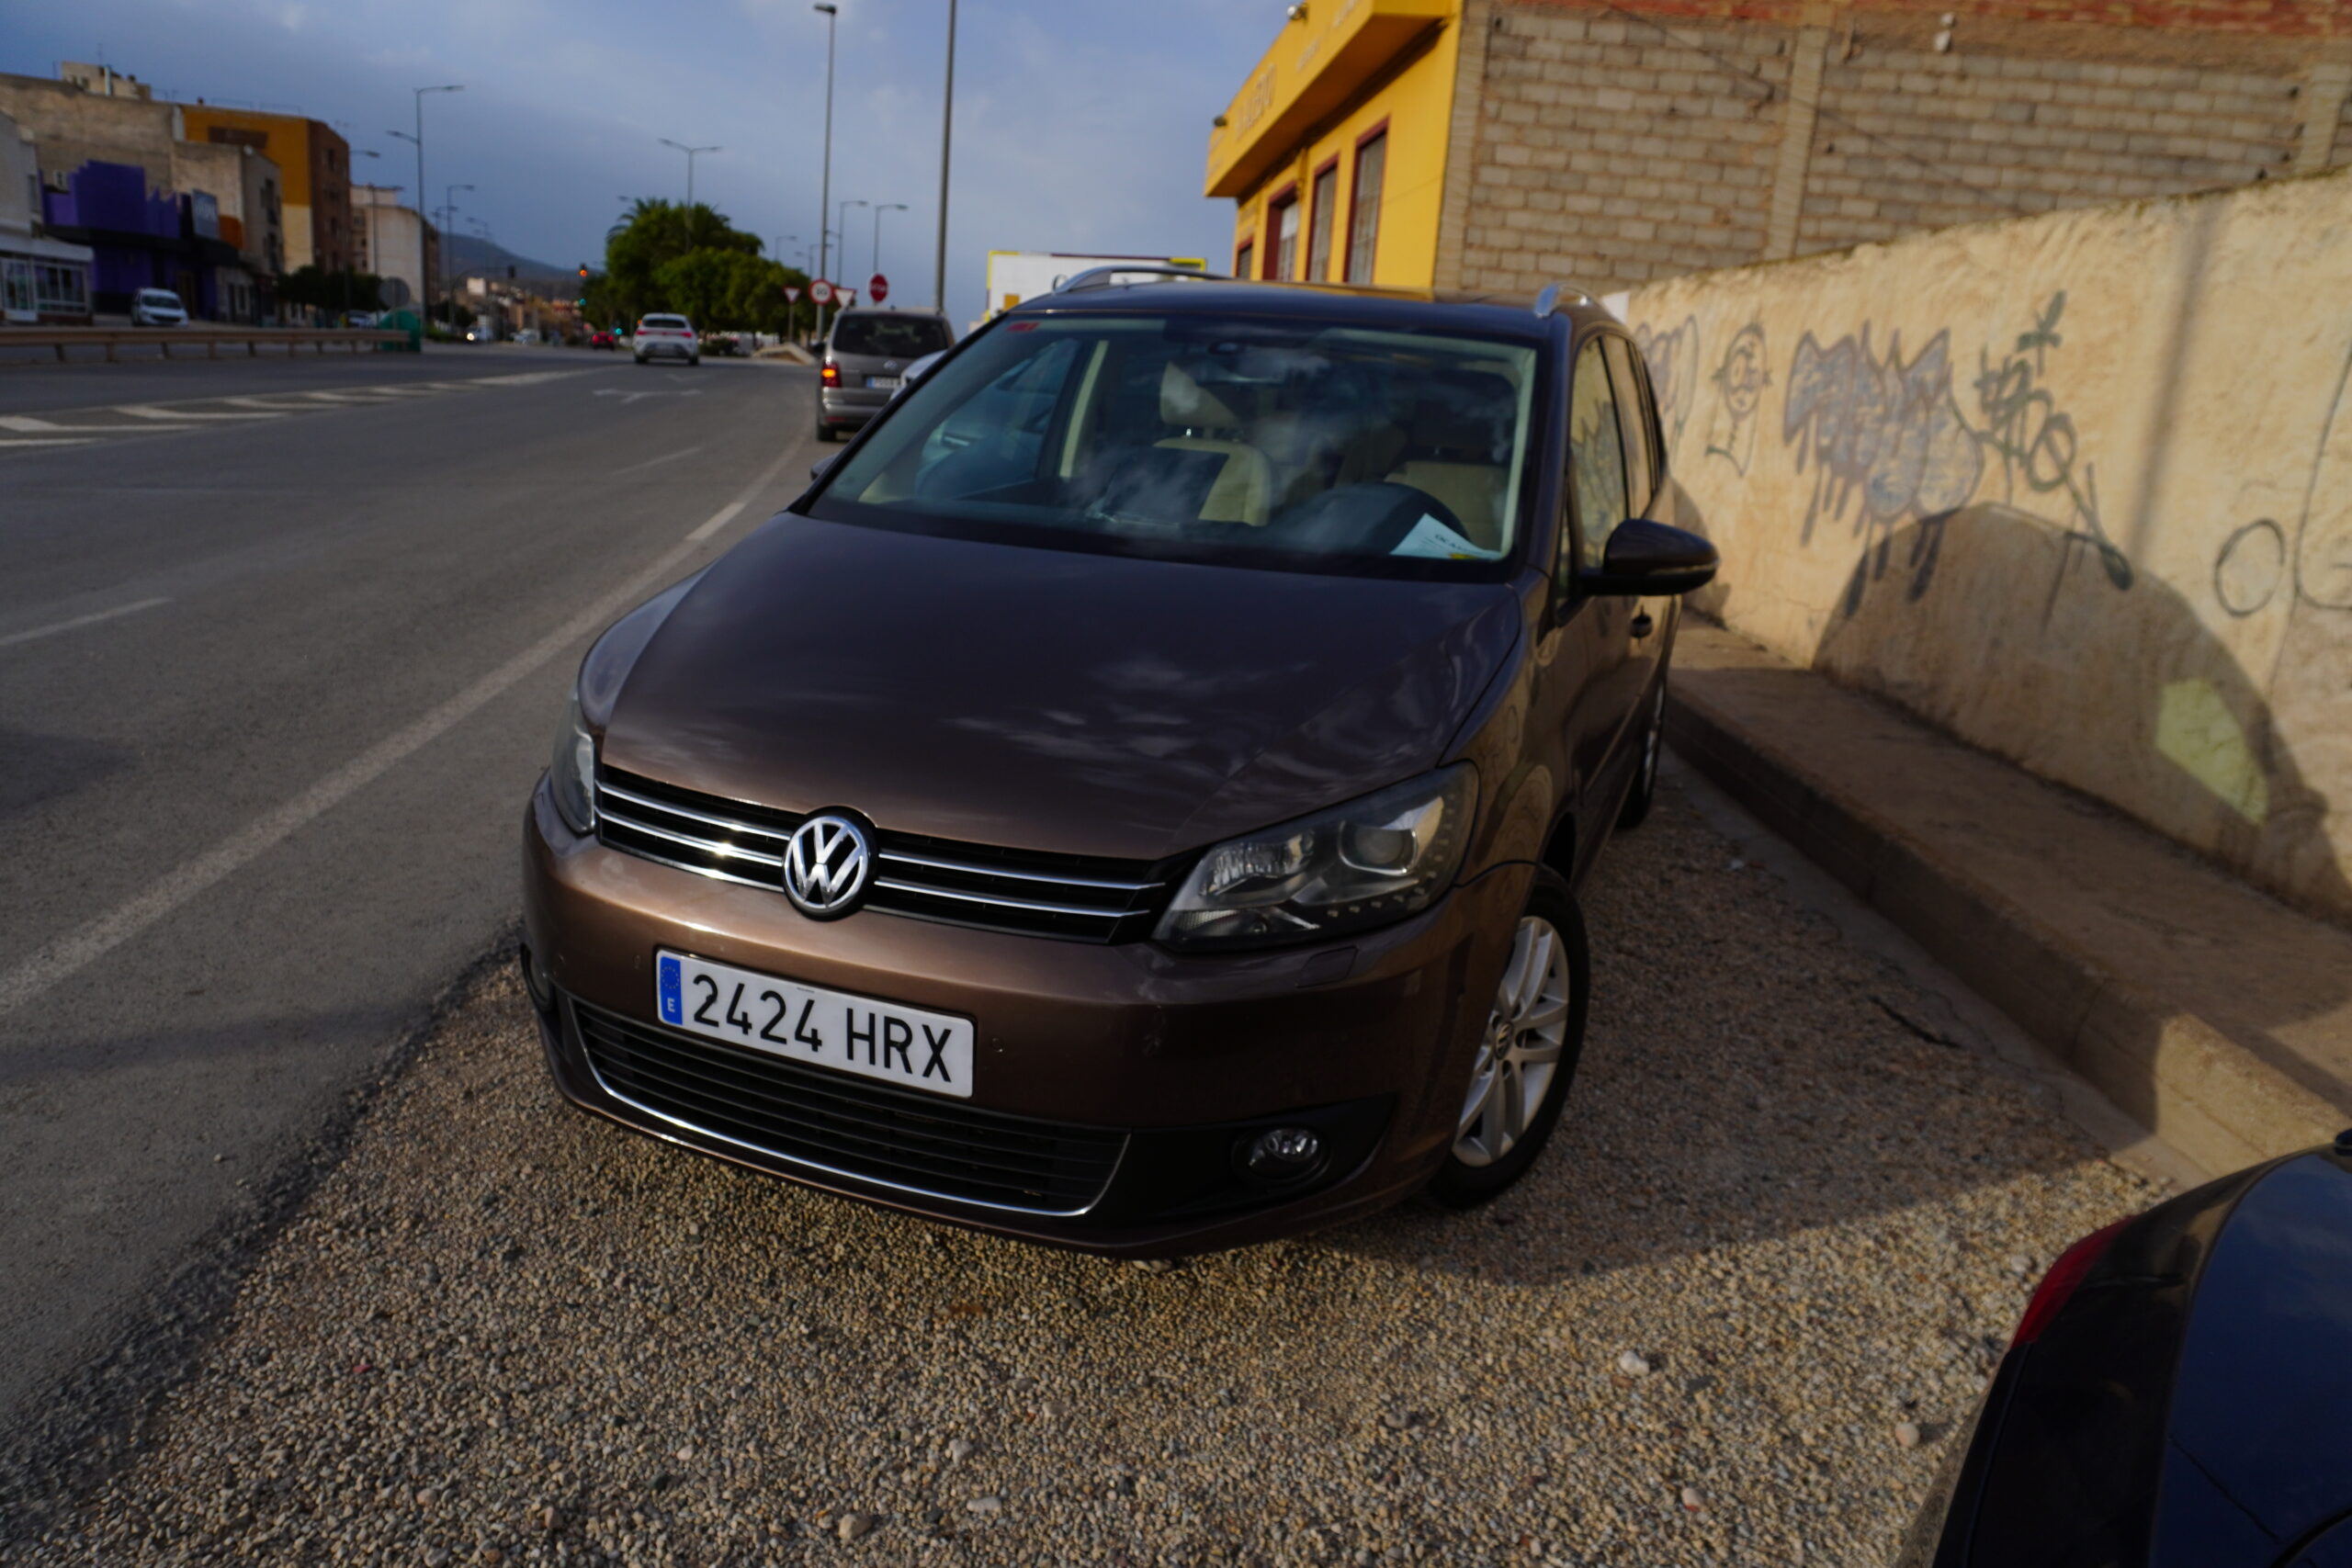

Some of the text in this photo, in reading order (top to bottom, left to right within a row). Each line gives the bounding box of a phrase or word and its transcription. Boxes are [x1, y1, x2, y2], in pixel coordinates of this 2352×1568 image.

[667, 997, 675, 1013] E
[692, 974, 953, 1083] 2424 HRX
